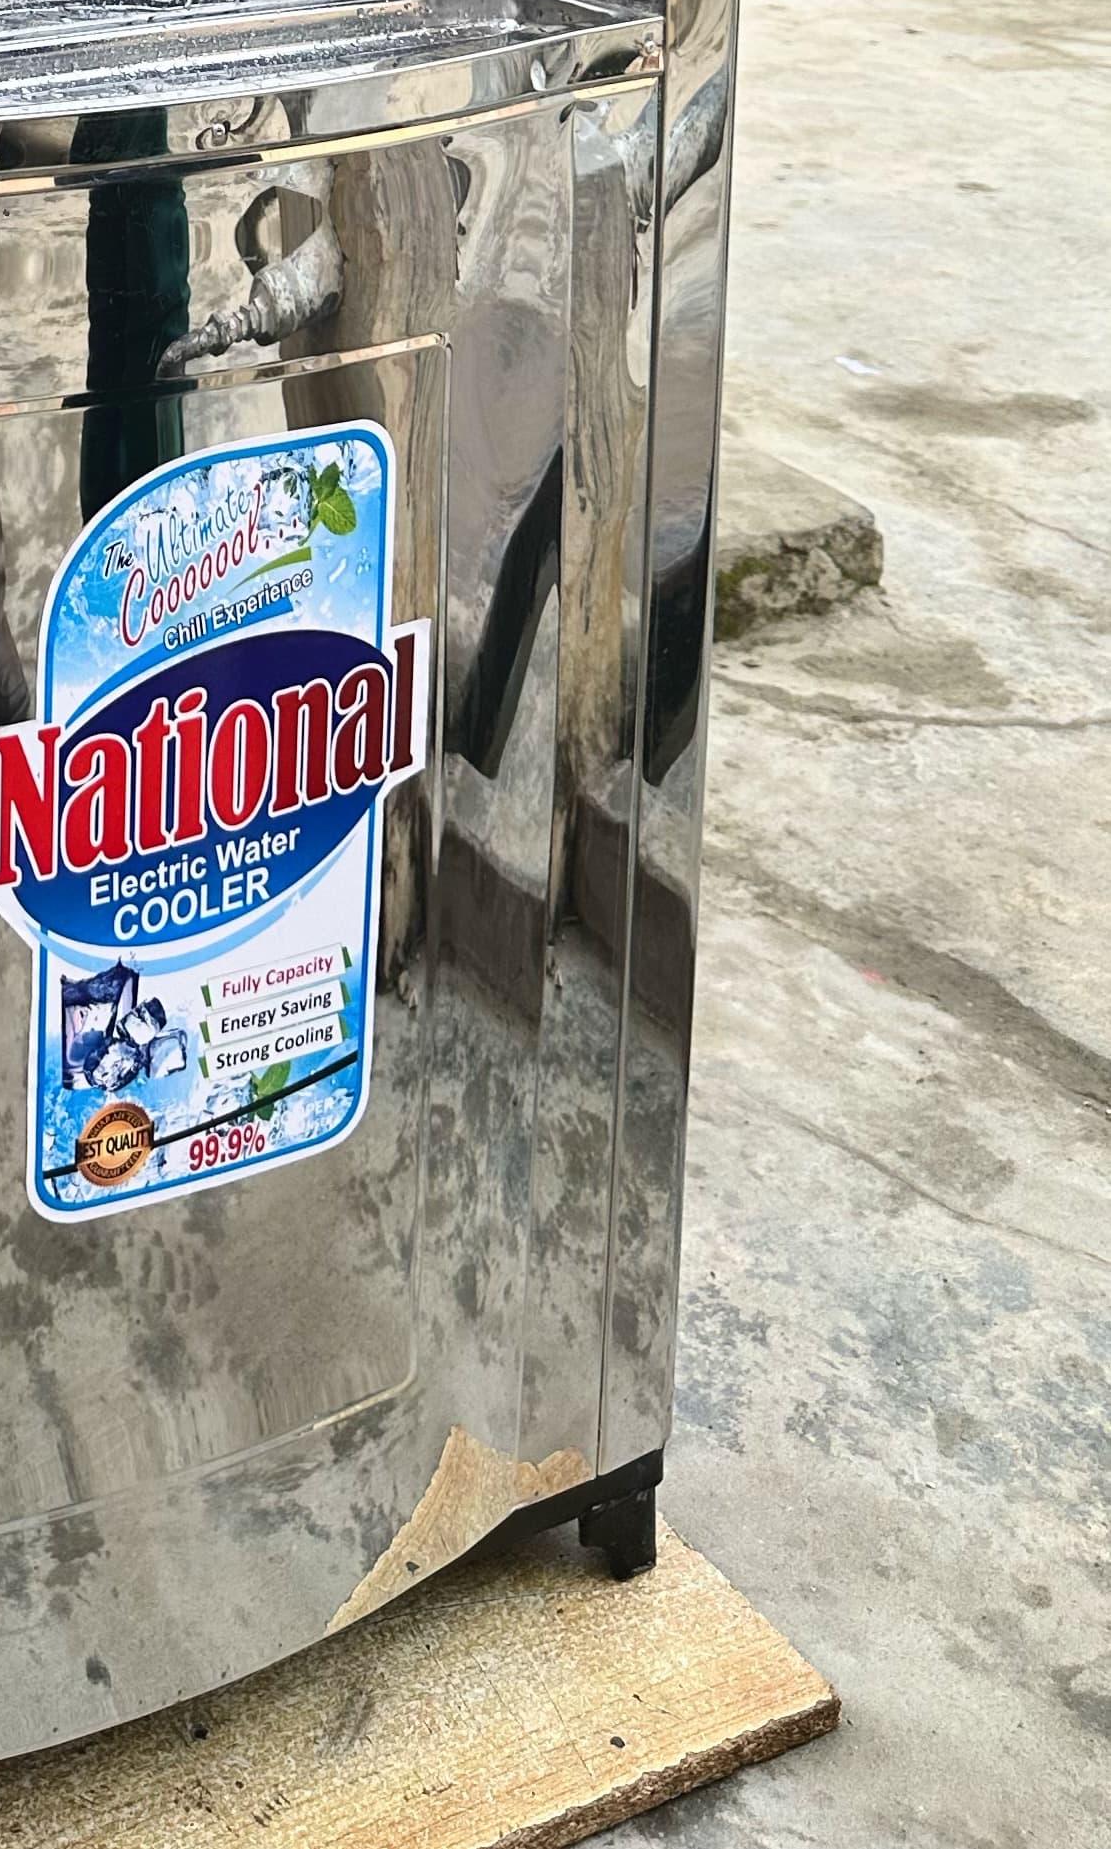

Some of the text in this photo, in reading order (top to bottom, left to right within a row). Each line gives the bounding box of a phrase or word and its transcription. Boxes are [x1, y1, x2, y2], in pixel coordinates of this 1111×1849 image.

[104, 485, 251, 583] The Ultimate
[164, 568, 314, 650] Chill Experience
[90, 827, 301, 907] Electric Water
[113, 866, 271, 942] COOLER
[222, 955, 333, 998] Fully Capacity
[220, 992, 332, 1034] Energy Saving
[216, 1024, 333, 1069] Strong Cooling
[83, 1130, 147, 1159] EST QUALIT
[189, 1120, 265, 1172] 99.9%
